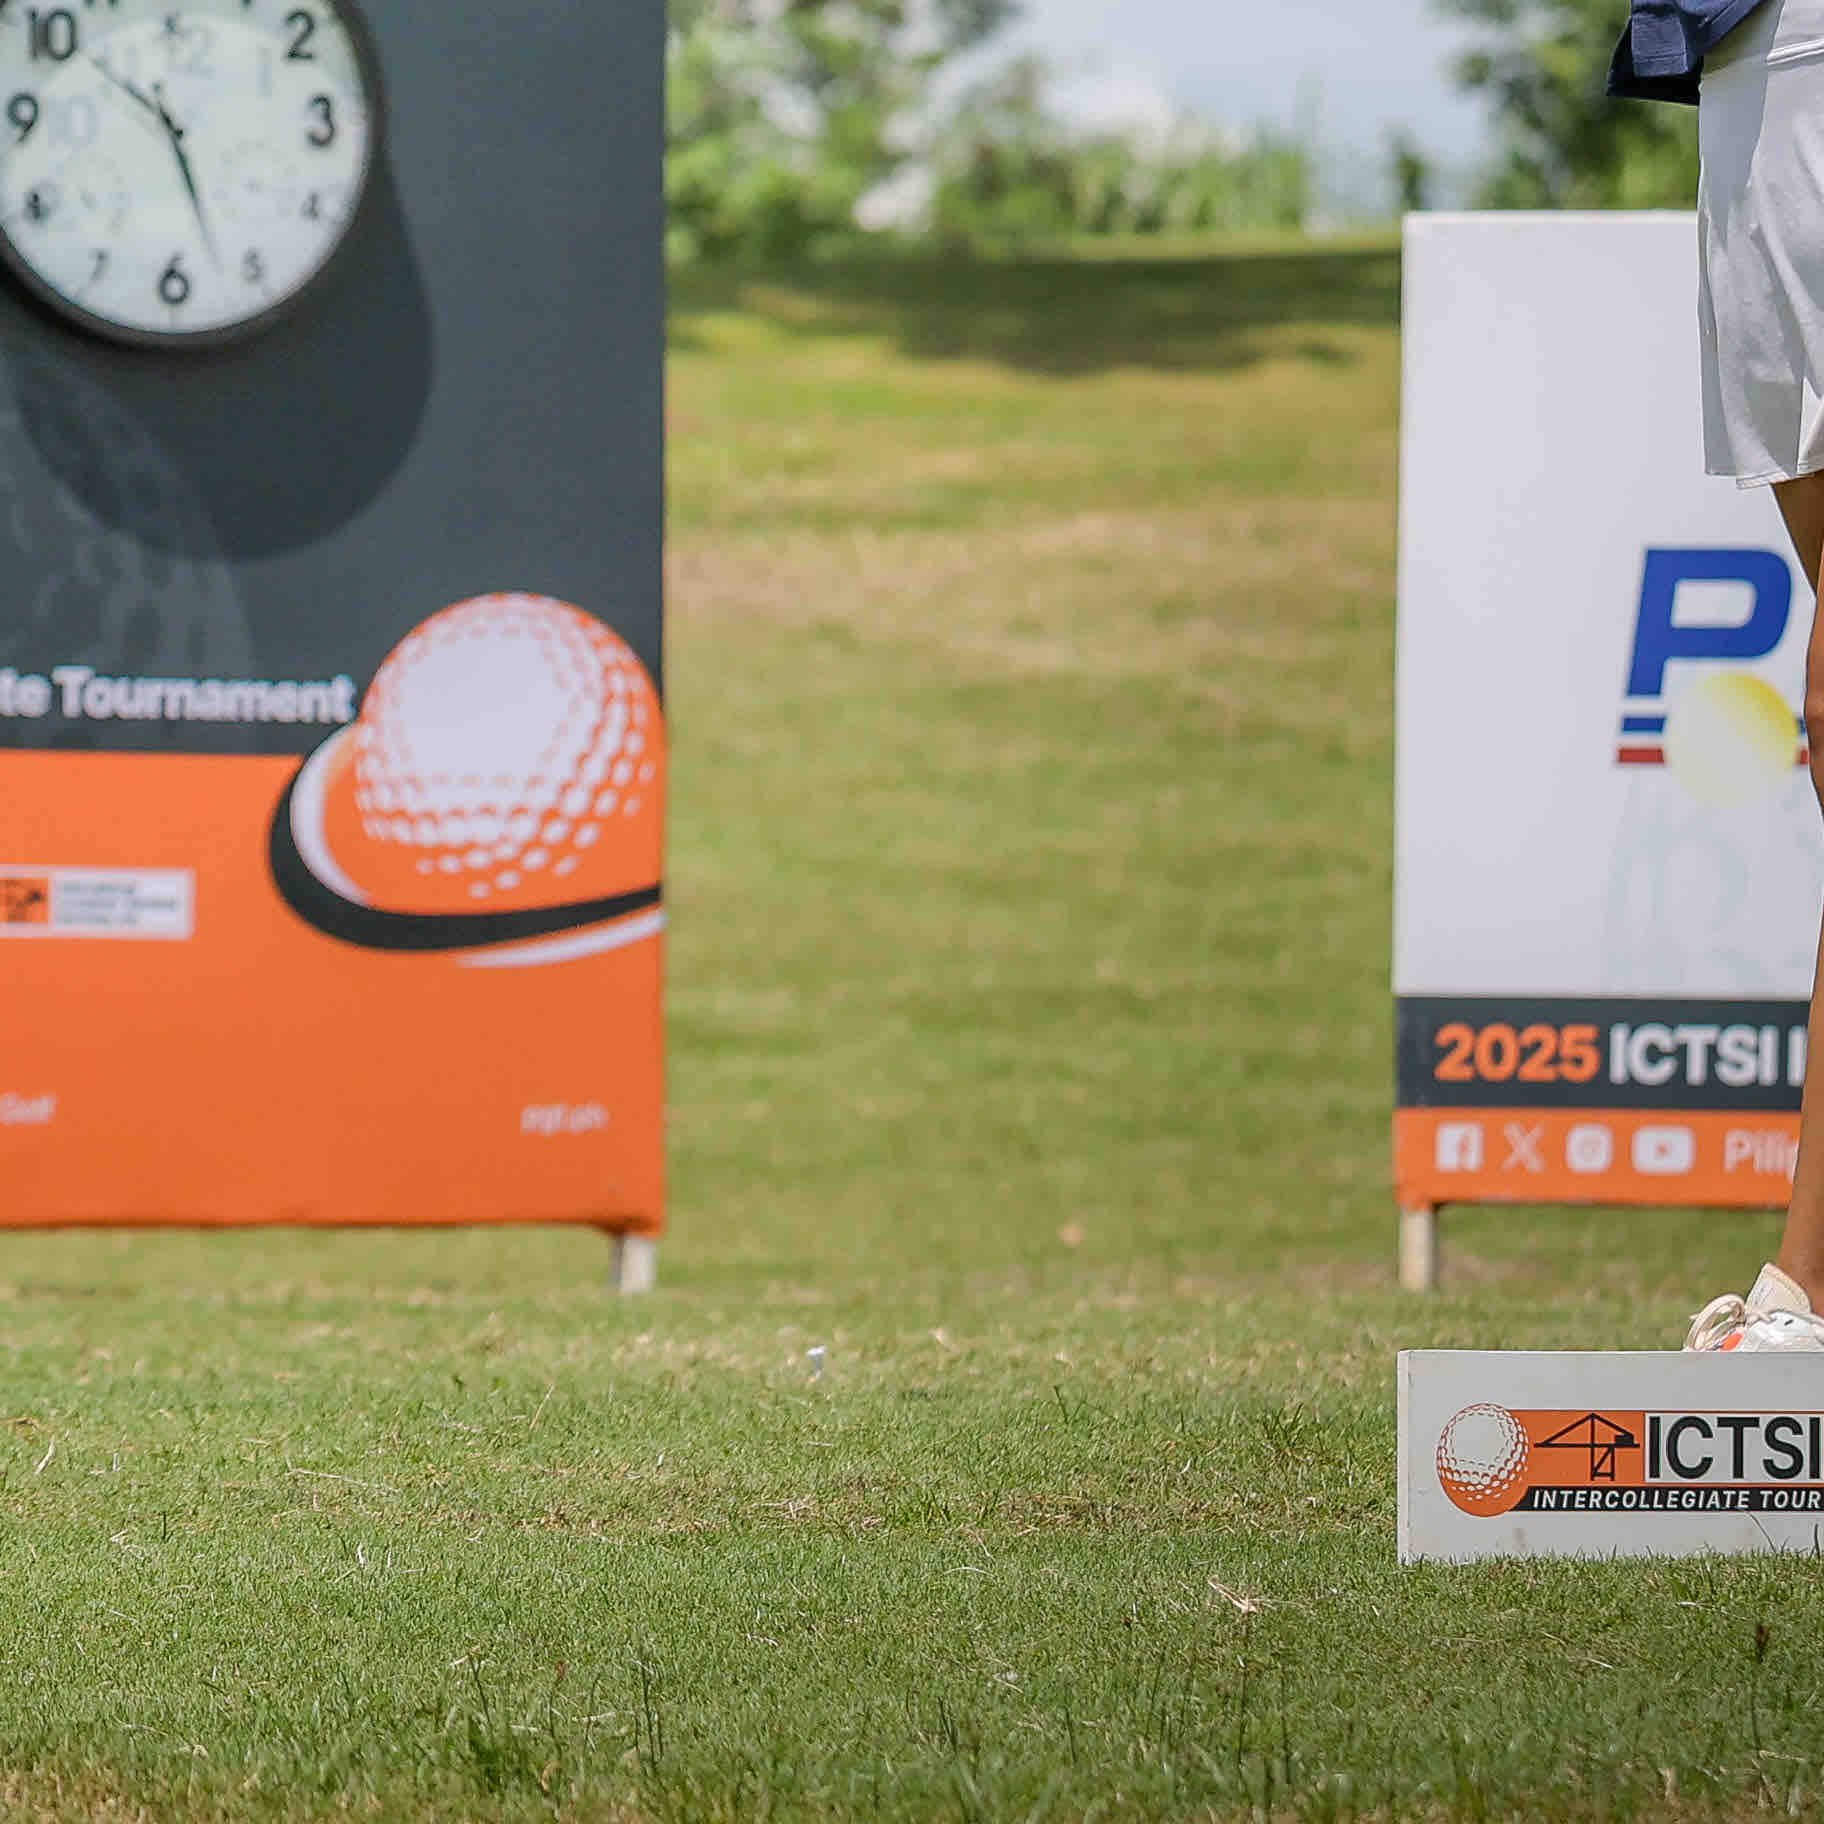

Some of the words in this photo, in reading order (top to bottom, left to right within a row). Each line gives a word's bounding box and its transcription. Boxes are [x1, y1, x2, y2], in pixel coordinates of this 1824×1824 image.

[28, 6, 78, 62] 10
[286, 8, 316, 60] 2
[6, 91, 39, 145] 9
[306, 94, 335, 148] 3
[158, 251, 190, 306] 6
[52, 665, 356, 724] Tournament
[1433, 1022, 1601, 1084] 2025
[1608, 1022, 1779, 1087] ICTSI
[1648, 1415, 1822, 1480] ICTSI
[1532, 1488, 1750, 1510] INTERCOLLEGIATE
[1759, 1489, 1822, 1510] TOUR
